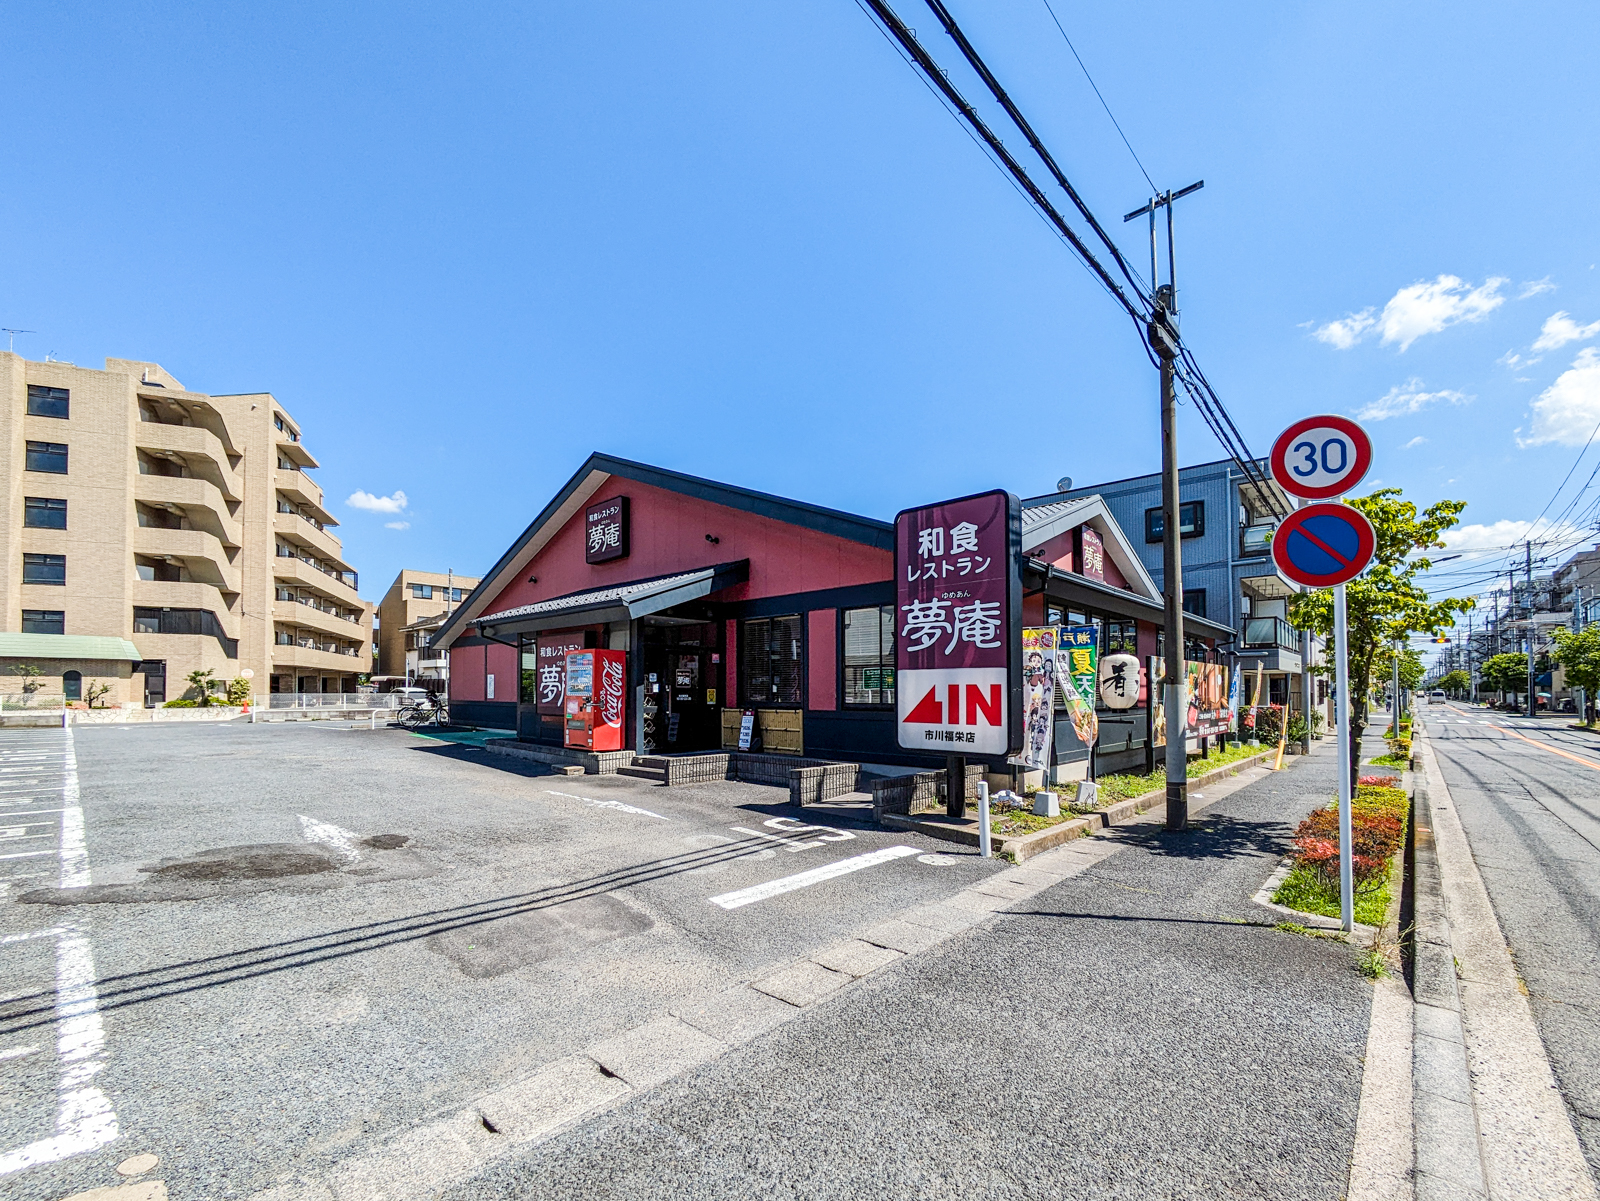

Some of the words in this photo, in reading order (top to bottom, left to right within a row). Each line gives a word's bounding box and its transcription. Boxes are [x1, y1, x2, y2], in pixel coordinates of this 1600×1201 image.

[1293, 437, 1347, 477] 30
[588, 506, 620, 522] 和食レストラン
[588, 523, 620, 553] 夢庵
[918, 521, 978, 559] 和食
[907, 556, 991, 582] レストラン
[941, 589, 971, 599] ゆめあん
[901, 598, 1002, 656] 夢庵
[539, 664, 566, 707] 夢
[948, 684, 1002, 727] IN
[924, 730, 976, 743] 市川福栄店
